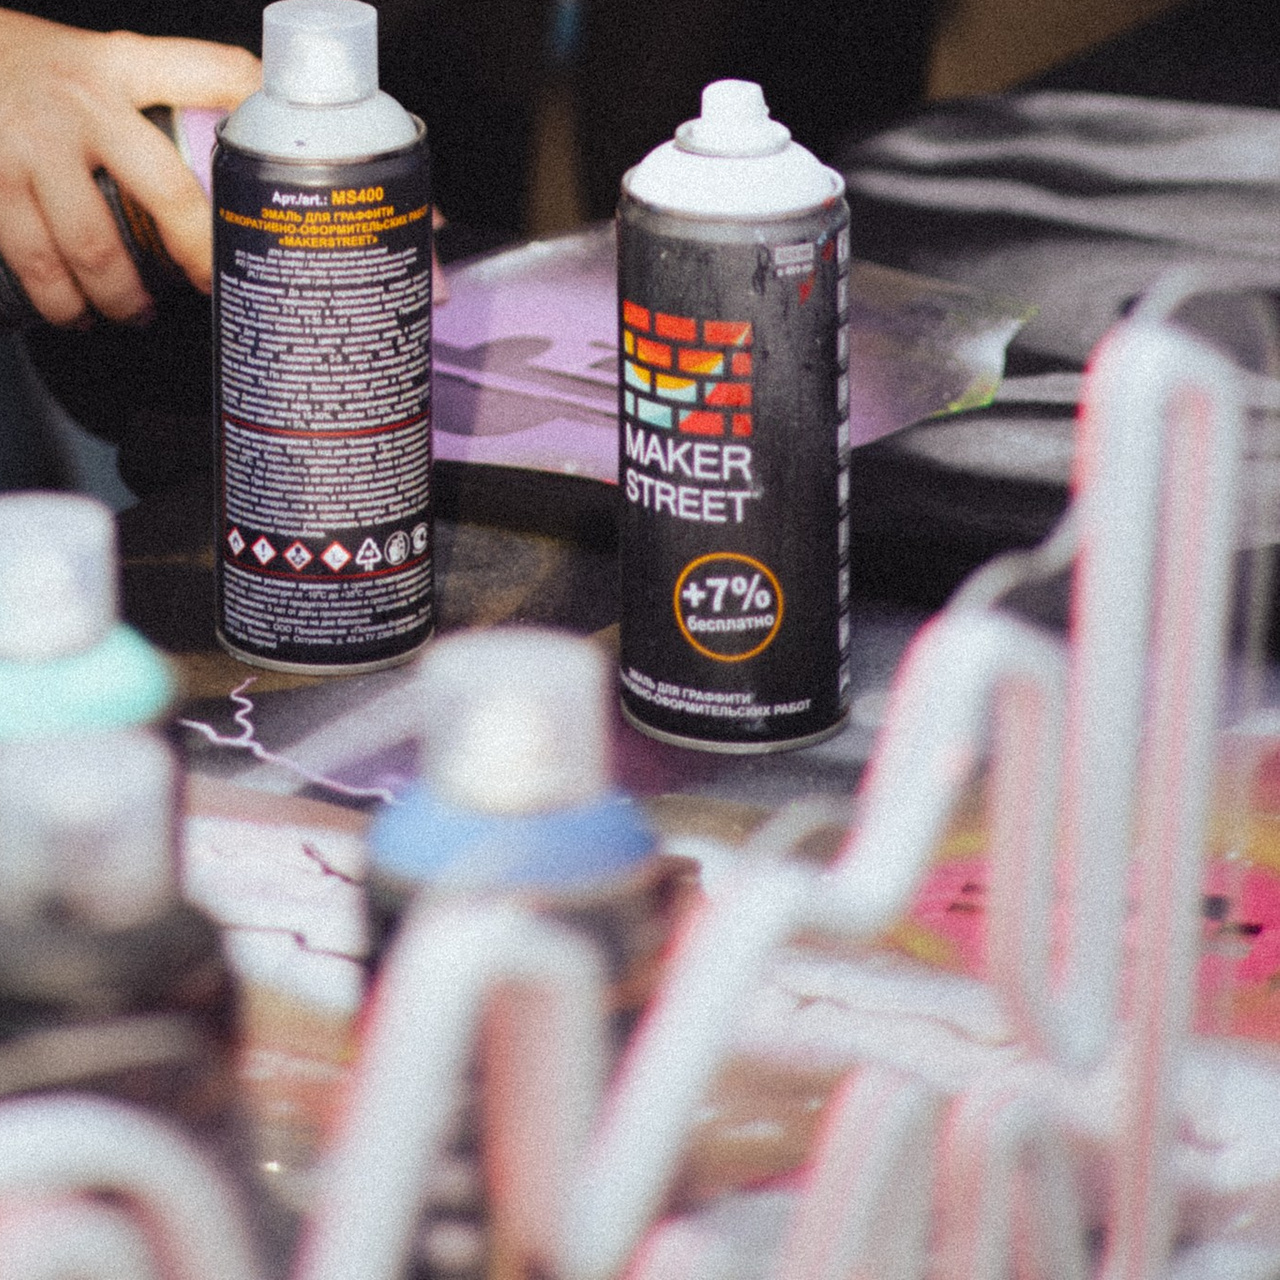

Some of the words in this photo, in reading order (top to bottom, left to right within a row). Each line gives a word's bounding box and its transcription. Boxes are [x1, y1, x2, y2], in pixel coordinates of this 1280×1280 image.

[331, 186, 384, 206] MS400
[261, 207, 302, 223] ЭМАЛЬ
[305, 211, 331, 224] ДЛЯ
[334, 205, 394, 222] ГРАФФИТИ
[625, 422, 752, 481] MAKER
[625, 467, 752, 523] STREET
[683, 573, 770, 612] +7%
[687, 614, 775, 632] бесплатно
[657, 681, 680, 697] ДЛЯ
[682, 687, 752, 705] ГРАФФИТИ
[774, 699, 812, 716] РАБОТ
